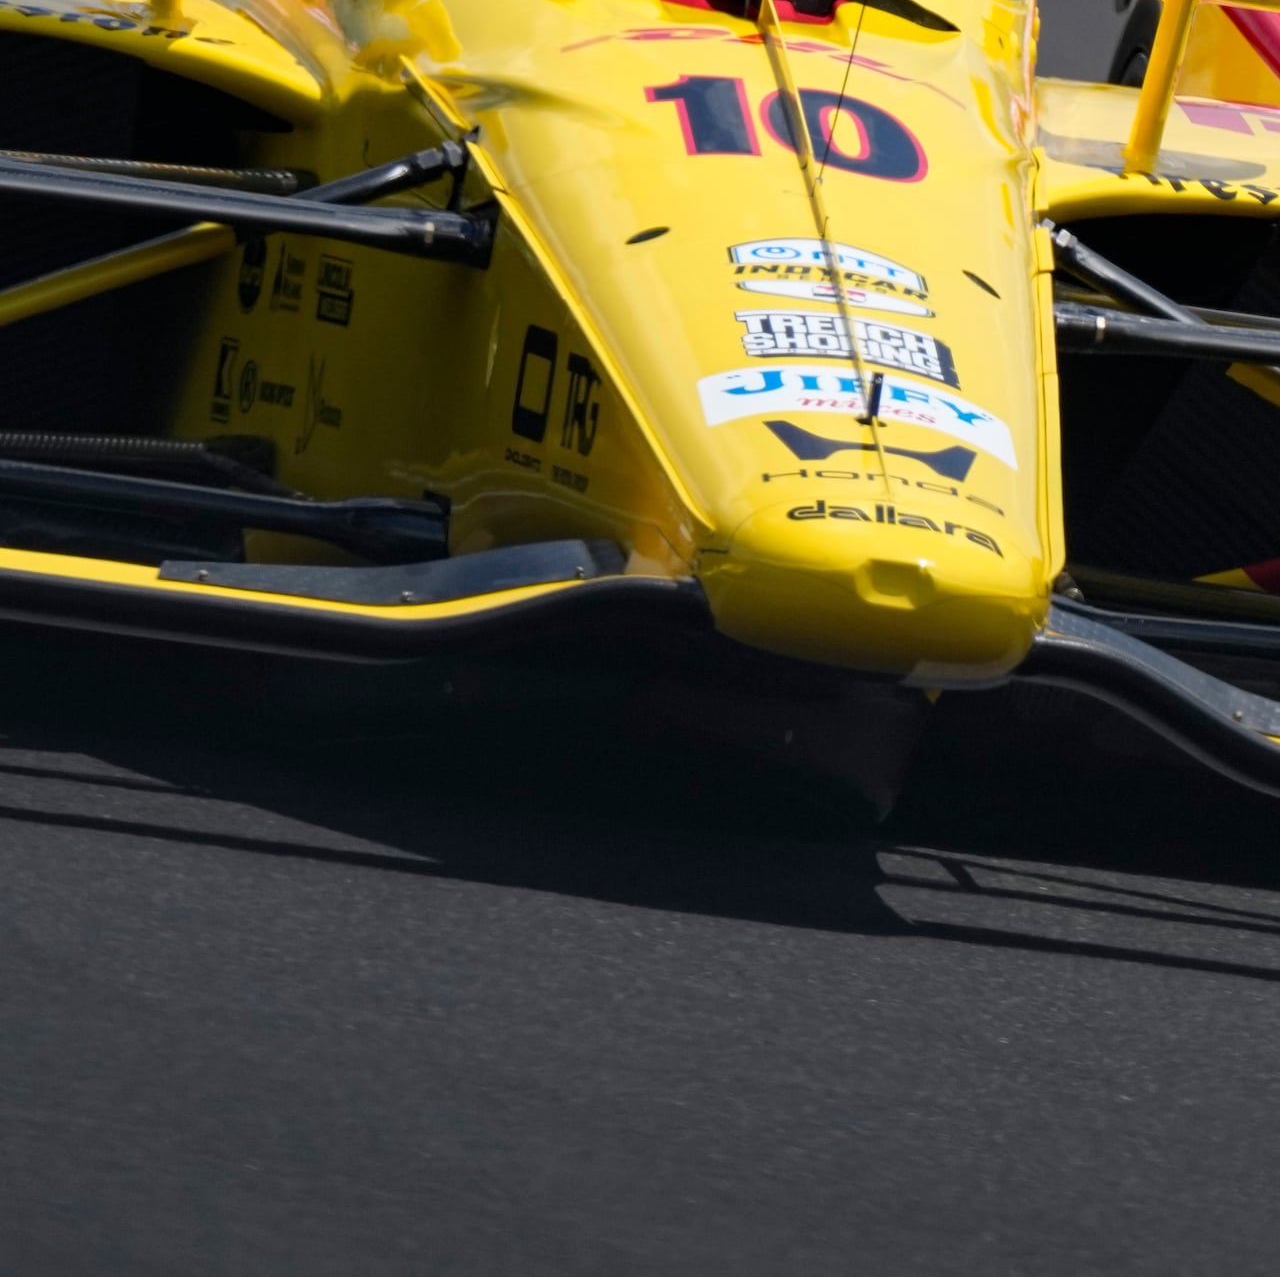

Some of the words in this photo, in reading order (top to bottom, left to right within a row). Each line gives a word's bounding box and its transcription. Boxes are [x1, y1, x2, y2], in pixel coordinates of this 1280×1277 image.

[643, 74, 929, 184] 10
[734, 265, 929, 301] INDYCAR
[735, 314, 939, 354] TRENCH
[786, 499, 1005, 559] dallara
